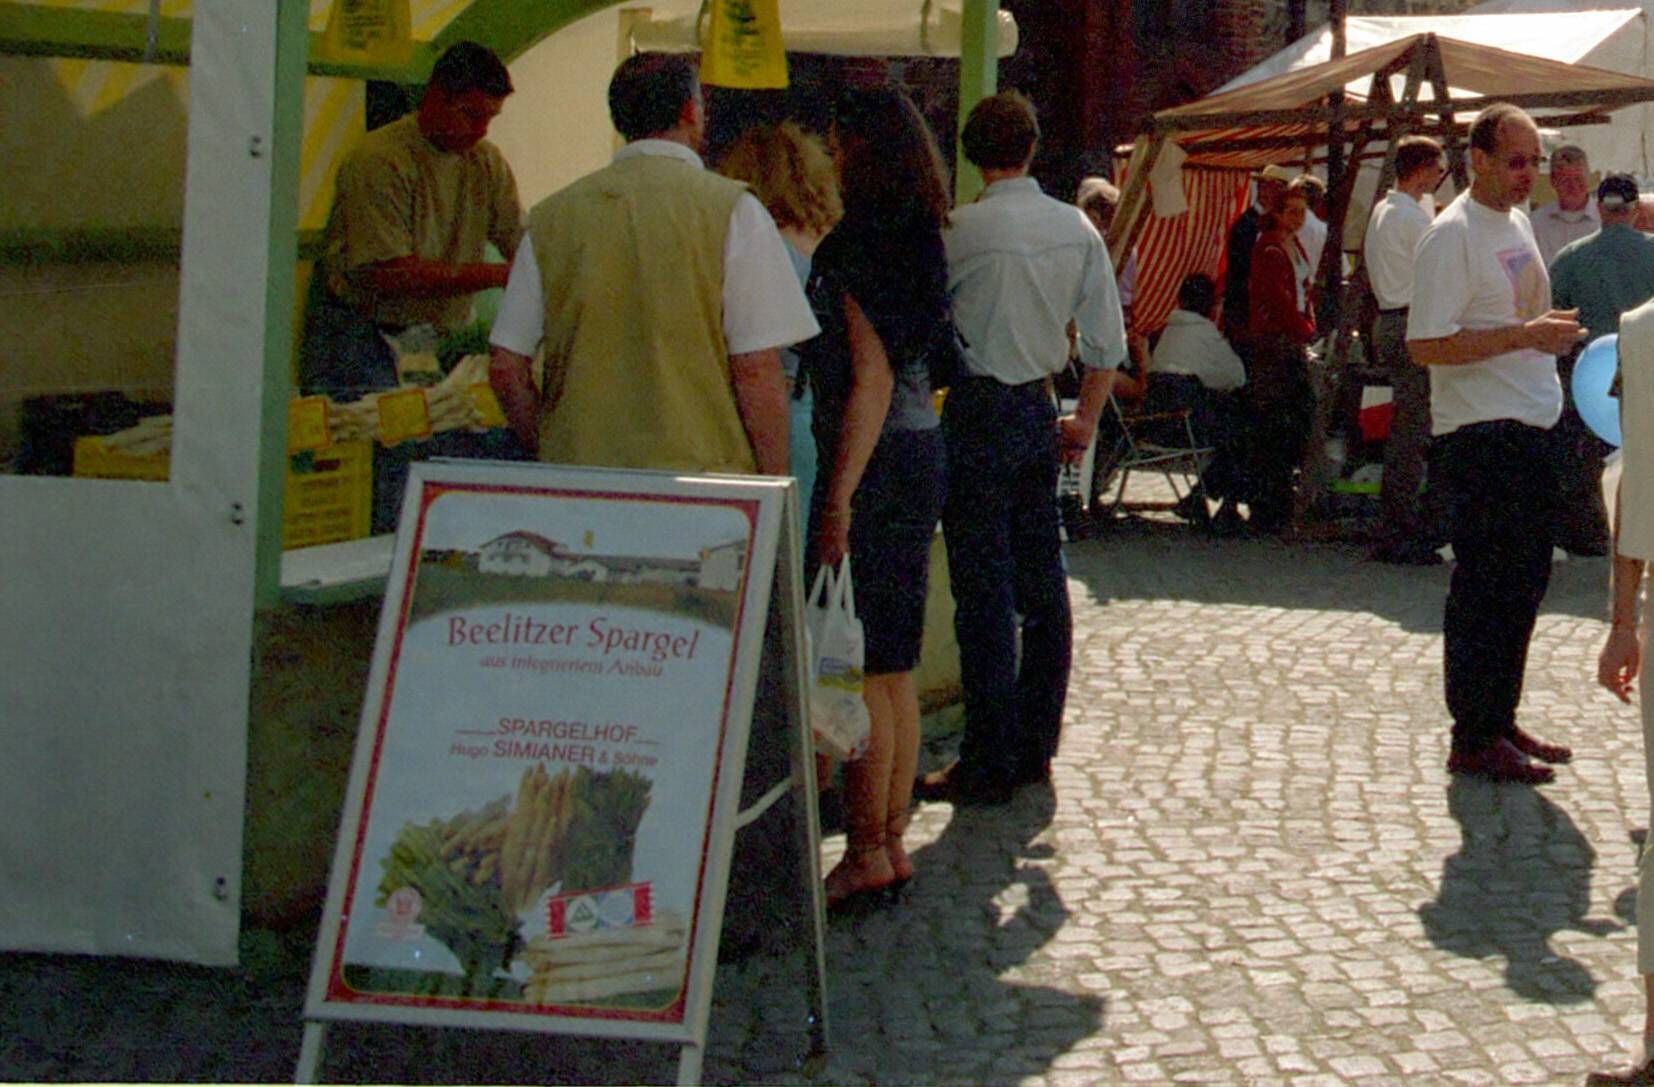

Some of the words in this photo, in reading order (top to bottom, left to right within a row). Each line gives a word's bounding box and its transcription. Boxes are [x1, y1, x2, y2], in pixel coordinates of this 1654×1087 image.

[447, 612, 578, 646] Beelitzer
[587, 616, 701, 662] Spargel
[607, 659, 664, 678] Anbau
[496, 717, 638, 744] SPARGELHOF
[449, 742, 489, 759] Hugo
[493, 739, 596, 763] SIMIANER
